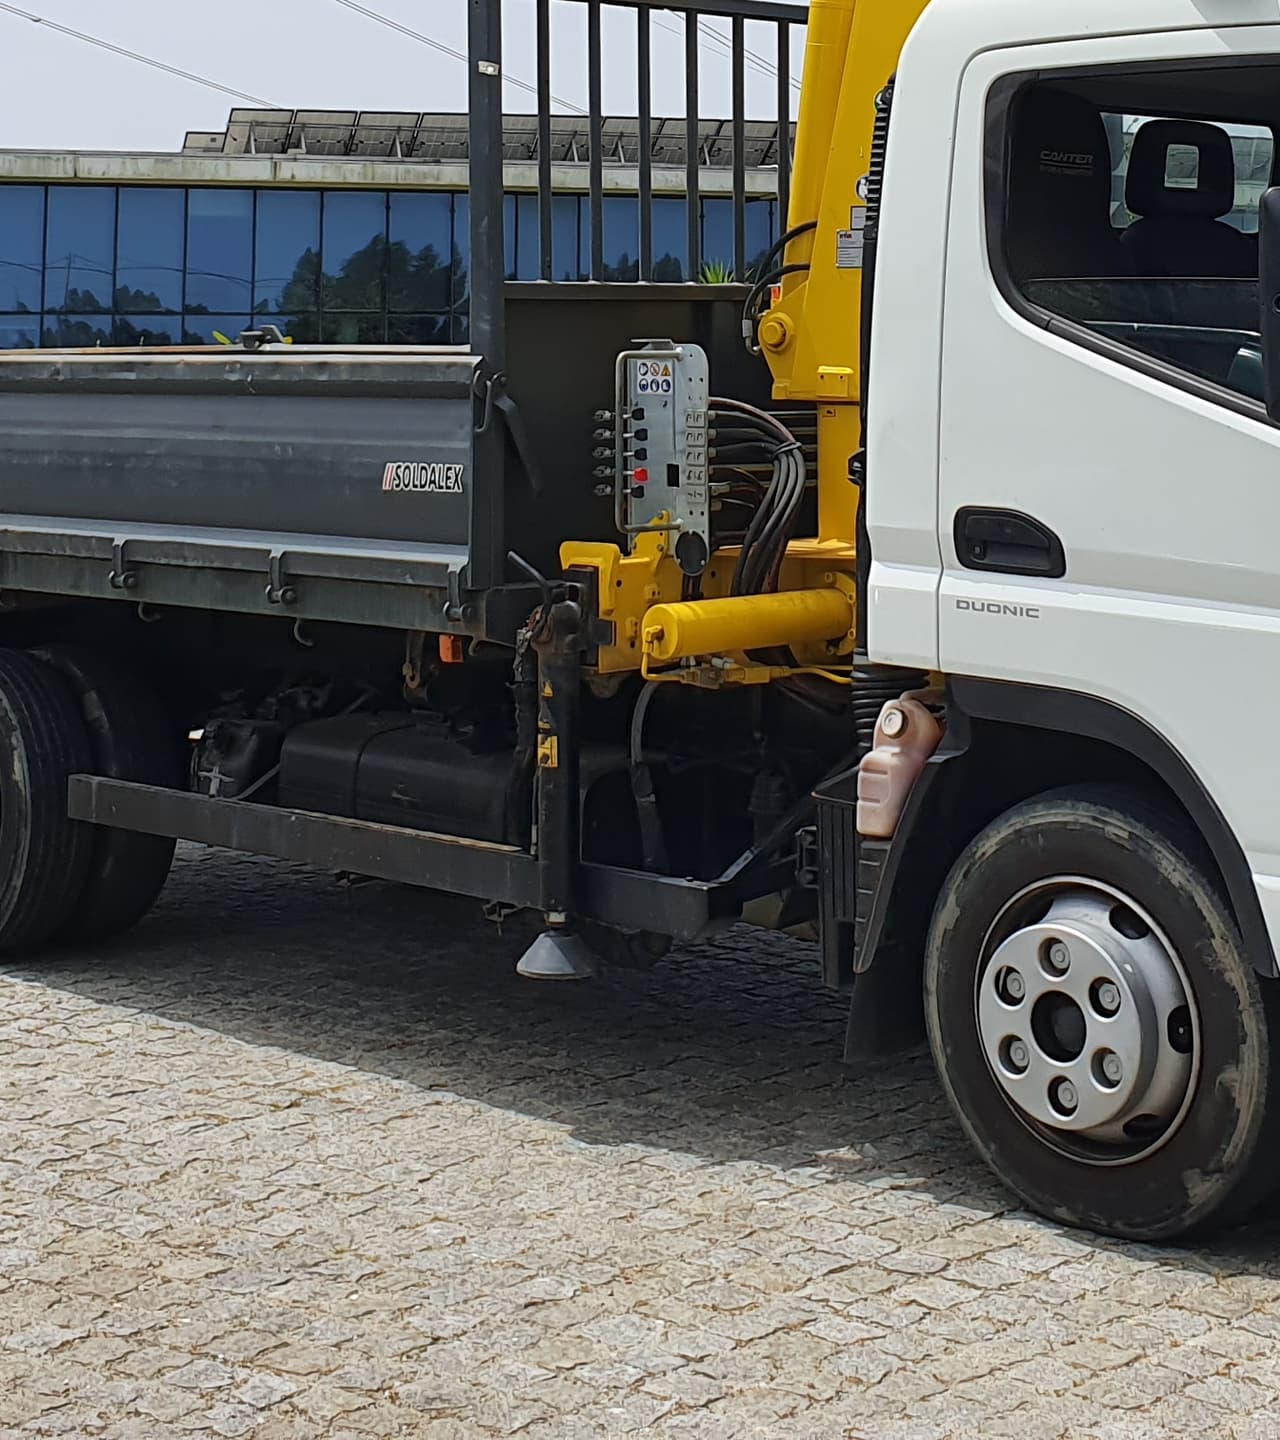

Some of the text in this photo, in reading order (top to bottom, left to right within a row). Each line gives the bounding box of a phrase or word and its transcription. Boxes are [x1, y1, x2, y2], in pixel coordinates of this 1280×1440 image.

[1040, 150, 1094, 164] CANTER
[393, 464, 462, 490] SOLDALEX
[956, 599, 1040, 618] DUONIC
